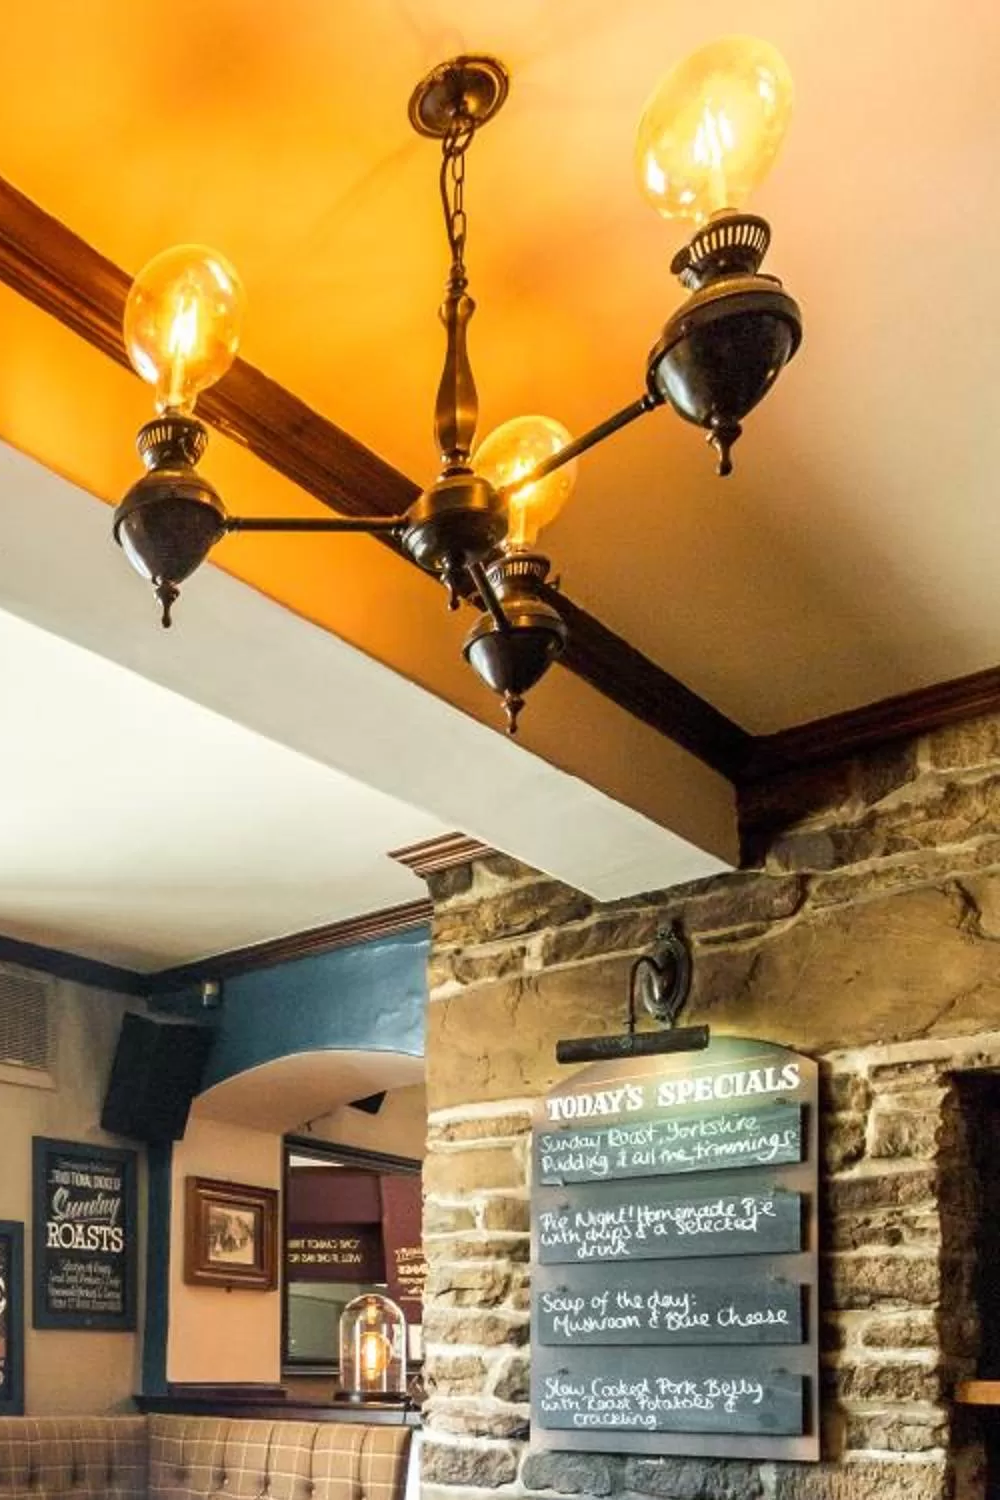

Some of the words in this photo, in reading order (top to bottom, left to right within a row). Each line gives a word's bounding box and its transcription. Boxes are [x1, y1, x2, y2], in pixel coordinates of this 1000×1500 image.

[545, 1083, 644, 1121] TODAY'S
[657, 1063, 800, 1107] SPECIALS
[541, 1134, 601, 1154] Sunday
[666, 1113, 759, 1142] Yorkshire
[541, 1152, 609, 1176] Pudding
[631, 1148, 656, 1166] all
[53, 1186, 121, 1224] Sunday
[539, 1212, 568, 1231] Pie
[637, 1200, 737, 1228] Homemade
[741, 1198, 777, 1221] Pie
[46, 1222, 124, 1252] ROASTS
[541, 1229, 581, 1247] with
[585, 1225, 632, 1245] chips
[653, 1223, 668, 1235] a
[676, 1216, 758, 1236] selected
[577, 1240, 631, 1259] drink
[543, 1294, 585, 1313] Soup
[591, 1291, 610, 1316] of
[616, 1290, 644, 1309] the
[553, 1313, 641, 1336] Mushroom
[665, 1310, 710, 1331] Blue
[717, 1306, 790, 1327] Cheese
[541, 1399, 580, 1412] with
[582, 1396, 631, 1412] Roast
[636, 1394, 715, 1411] Potatoes
[545, 1377, 585, 1400] Slow
[591, 1378, 650, 1398] Cooked
[655, 1377, 697, 1396] Pork
[703, 1378, 763, 1405] Belly
